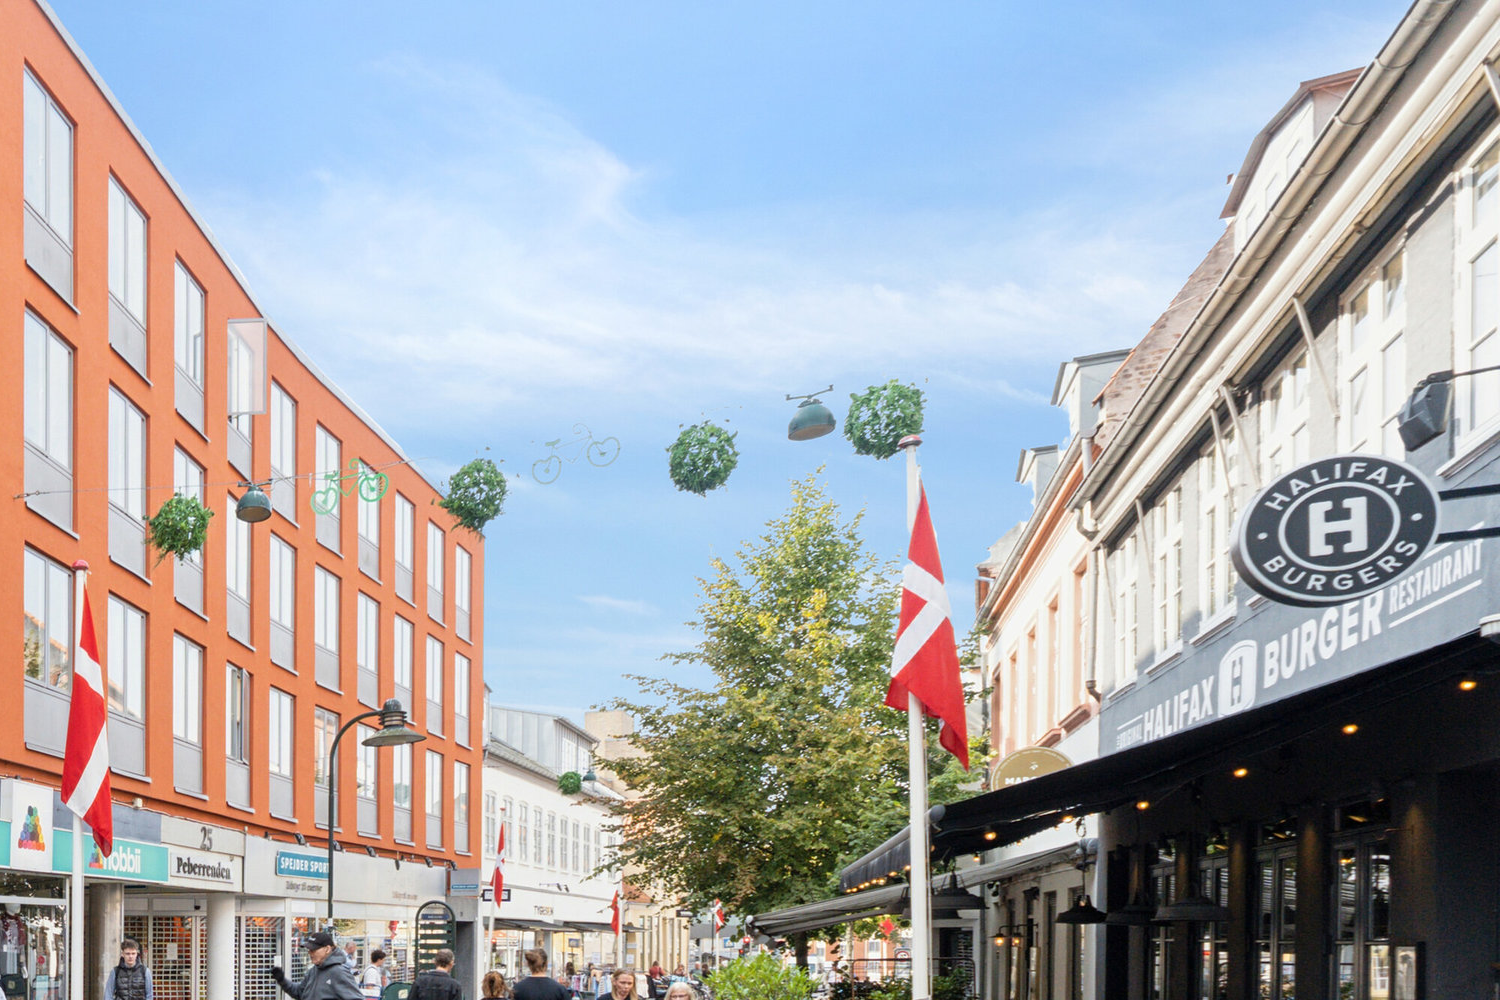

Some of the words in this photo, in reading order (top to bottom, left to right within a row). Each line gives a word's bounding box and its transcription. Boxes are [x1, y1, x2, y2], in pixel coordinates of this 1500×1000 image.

[1264, 462, 1415, 512] HALIFAX
[1308, 496, 1368, 557] H
[1263, 540, 1418, 591] BURGERS
[1143, 675, 1215, 743] HALIFAX
[1263, 589, 1385, 689] BURGER
[1389, 539, 1484, 615] RESTAURANT
[200, 826, 213, 852] 25
[280, 856, 309, 872] SPEJDER
[176, 856, 232, 880] Peberrenden
